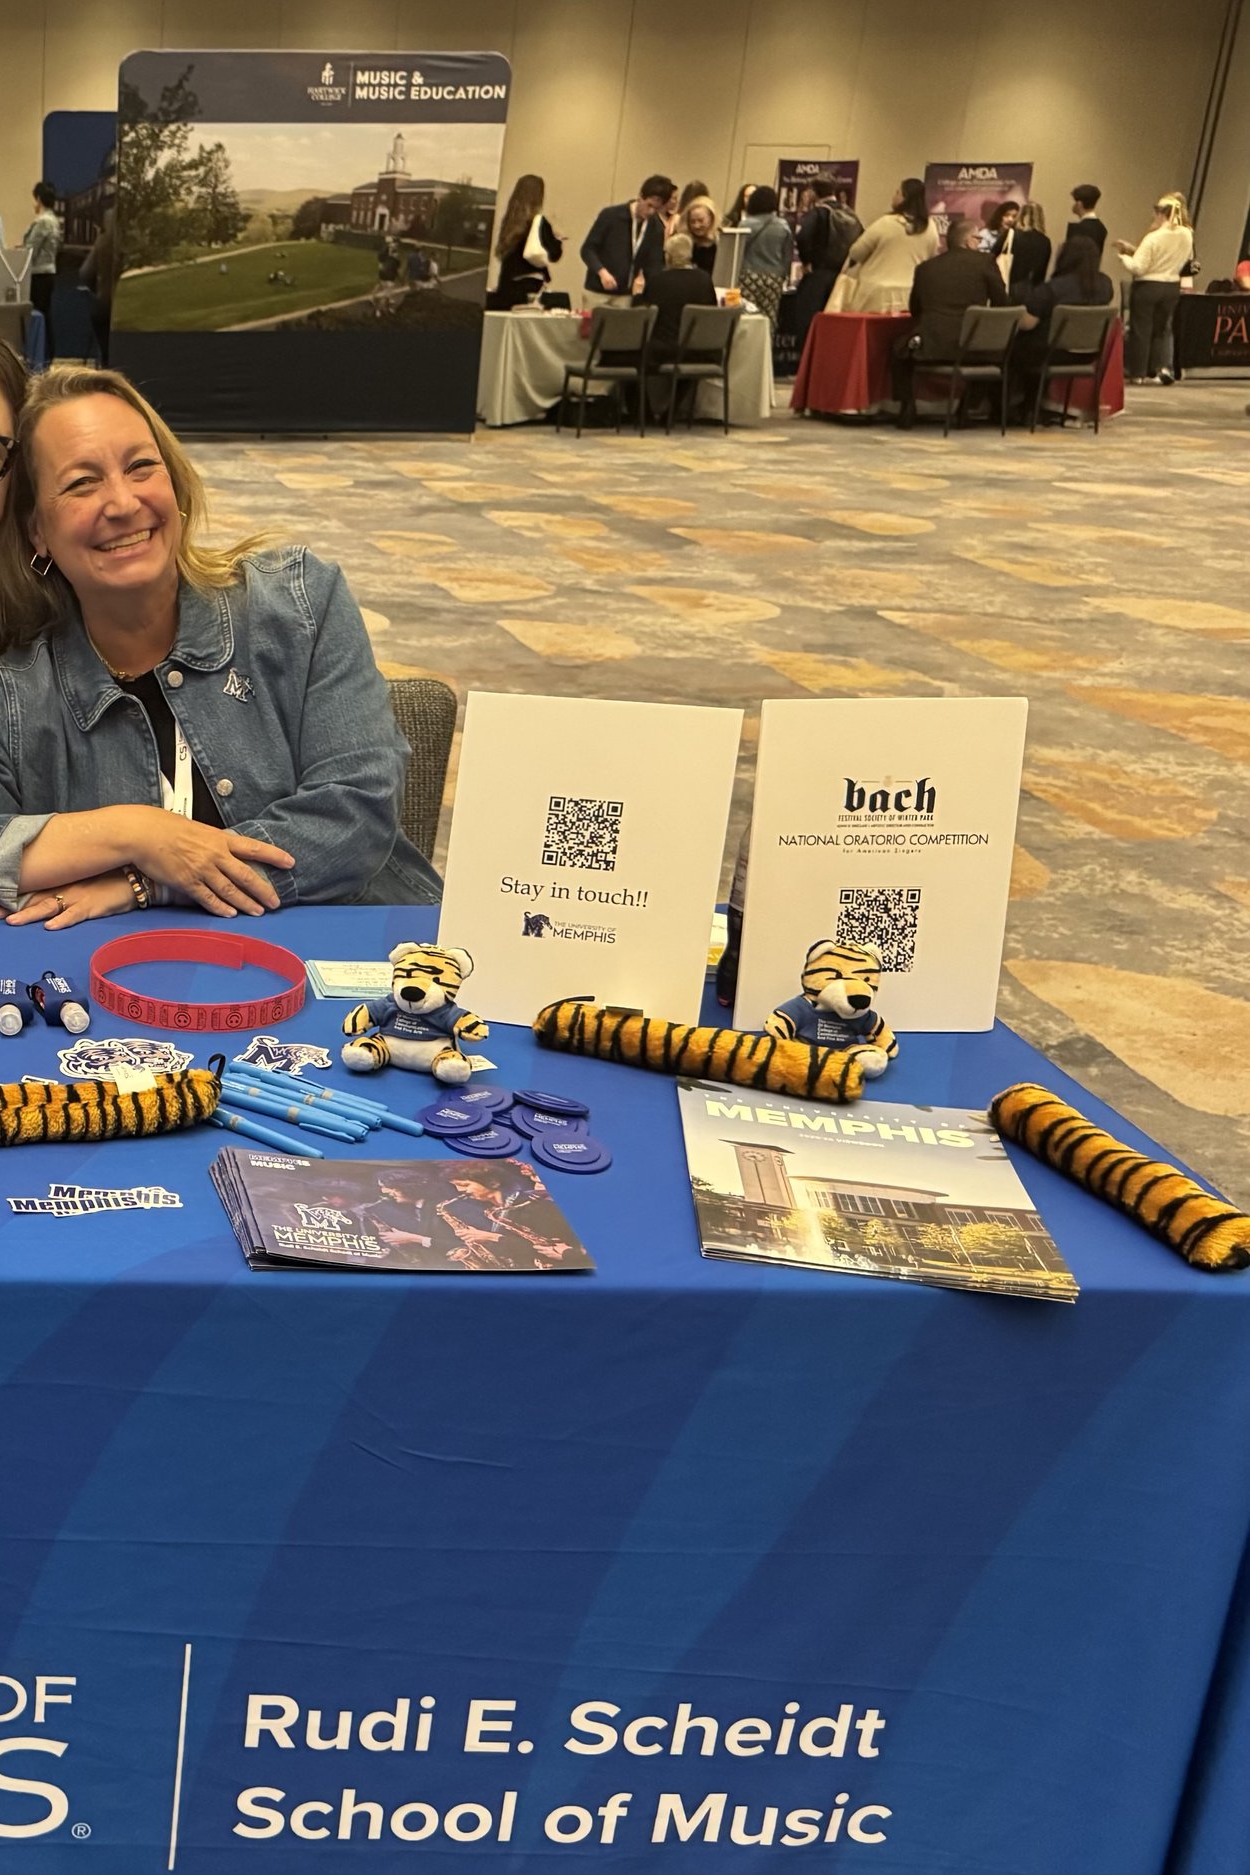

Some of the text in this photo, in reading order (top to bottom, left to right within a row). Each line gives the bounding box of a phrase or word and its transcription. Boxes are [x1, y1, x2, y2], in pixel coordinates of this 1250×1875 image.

[356, 71, 424, 85] MUSIC &
[355, 85, 506, 100] MUSIC EDUCATION
[958, 167, 998, 179] AMDA
[1214, 316, 1249, 343] PA
[843, 777, 936, 813] bach
[864, 814, 887, 822] SOCIETY
[778, 833, 989, 846] NATIONAL ORATORIO COMPETITION
[500, 876, 649, 908] Stay in touch!!
[552, 927, 616, 944] MEMPHIS
[705, 1100, 975, 1148] MEMPHIS
[250, 1160, 296, 1171] MUSIC
[15, 1195, 138, 1212] Memphis
[271, 1224, 294, 1233] THE
[295, 1227, 359, 1239] UNIVERSITY
[273, 1230, 381, 1251] MEMPHIS
[244, 1693, 886, 1759] Rudi E. Scheidt
[232, 1786, 893, 1847] School of Music
